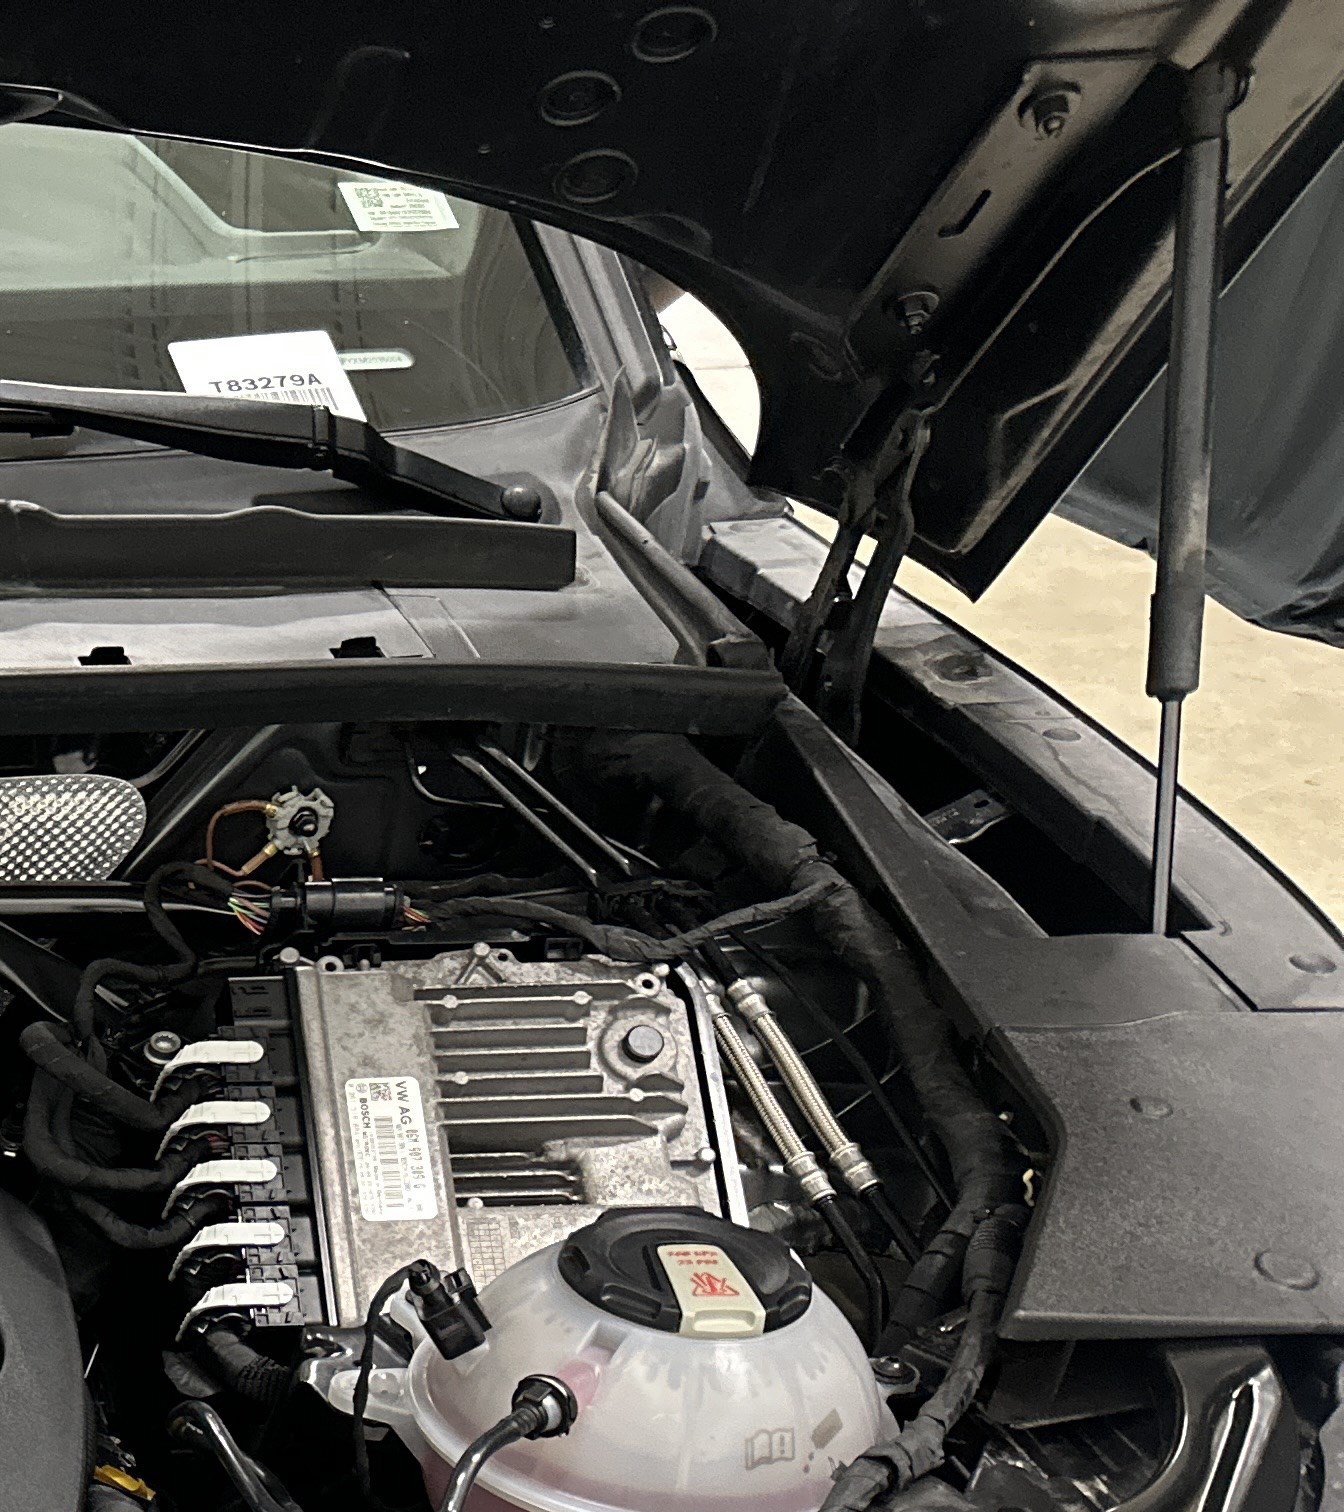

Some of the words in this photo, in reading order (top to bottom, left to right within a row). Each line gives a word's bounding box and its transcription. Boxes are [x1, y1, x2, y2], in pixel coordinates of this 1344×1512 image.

[208, 374, 322, 393] T83279A
[395, 1080, 409, 1102] VW
[359, 1097, 371, 1129] BOSCH
[399, 1106, 412, 1126] AG
